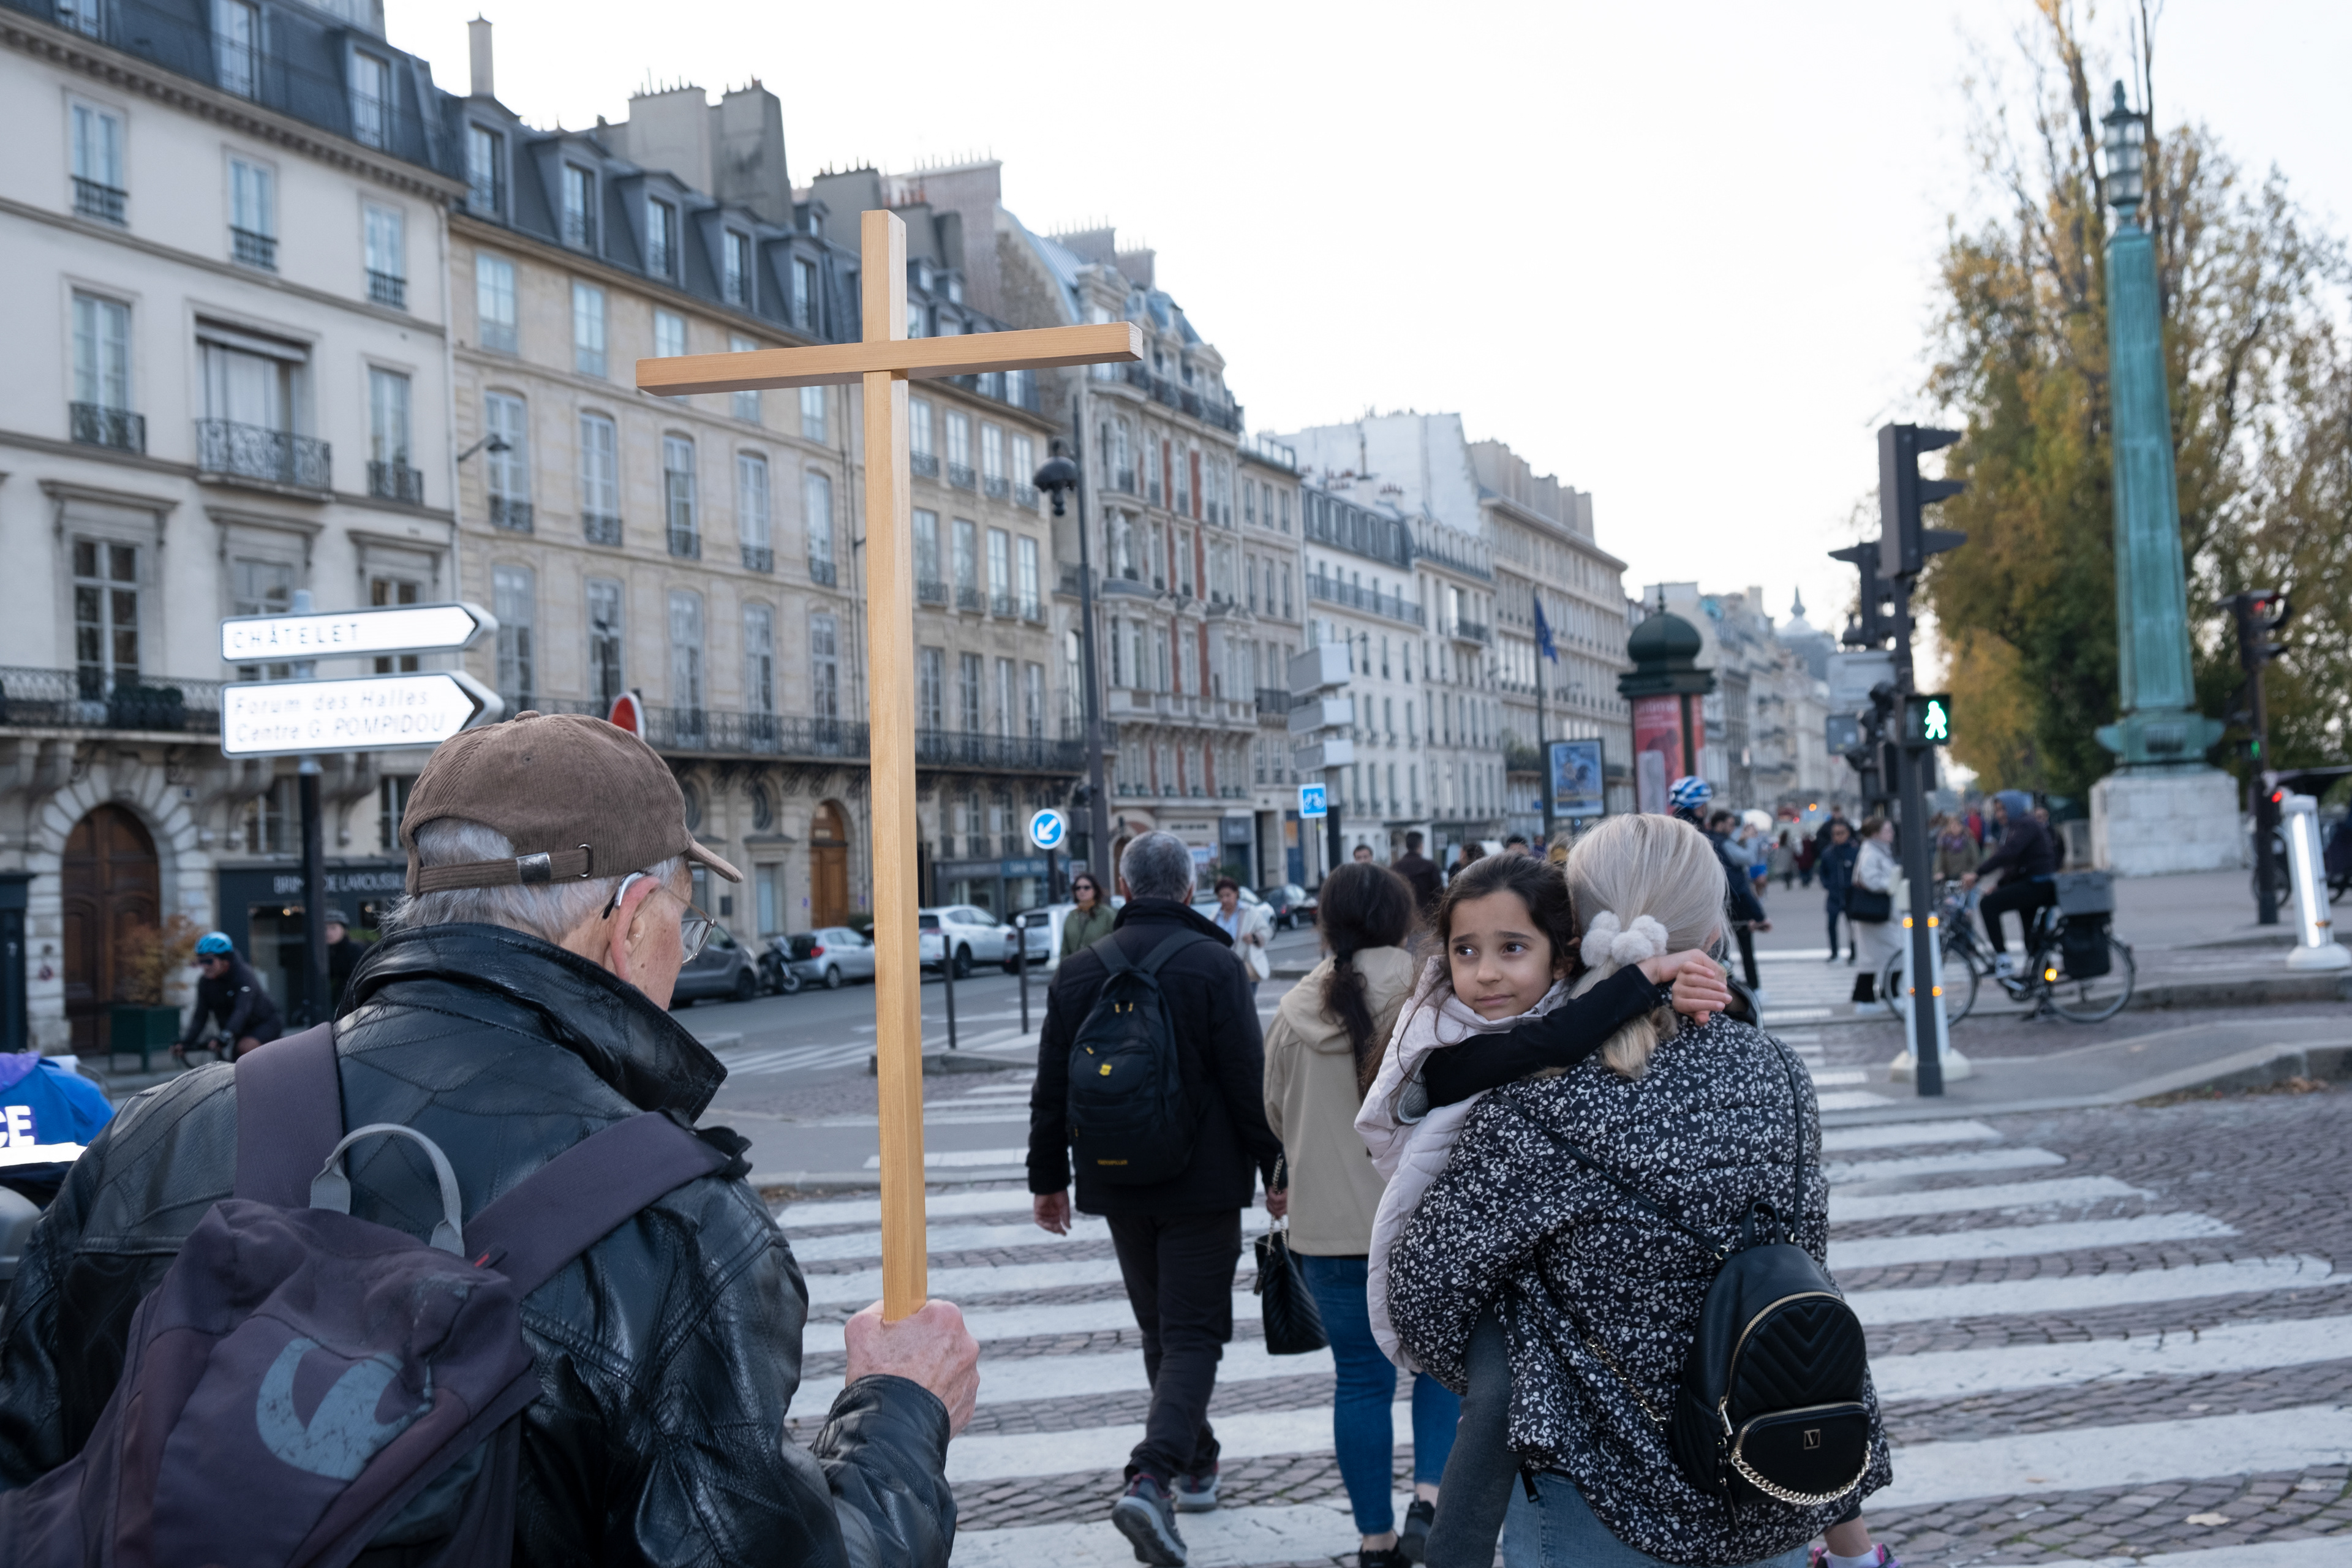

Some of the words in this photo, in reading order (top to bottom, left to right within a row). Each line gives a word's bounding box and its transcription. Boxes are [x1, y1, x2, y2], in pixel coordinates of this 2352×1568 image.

[233, 623, 360, 649] CHÂTELET
[233, 696, 301, 715] Forum
[312, 693, 349, 711] des
[360, 688, 428, 709] Halles
[235, 722, 300, 742] Centre
[333, 711, 446, 736] POMPIDOU
